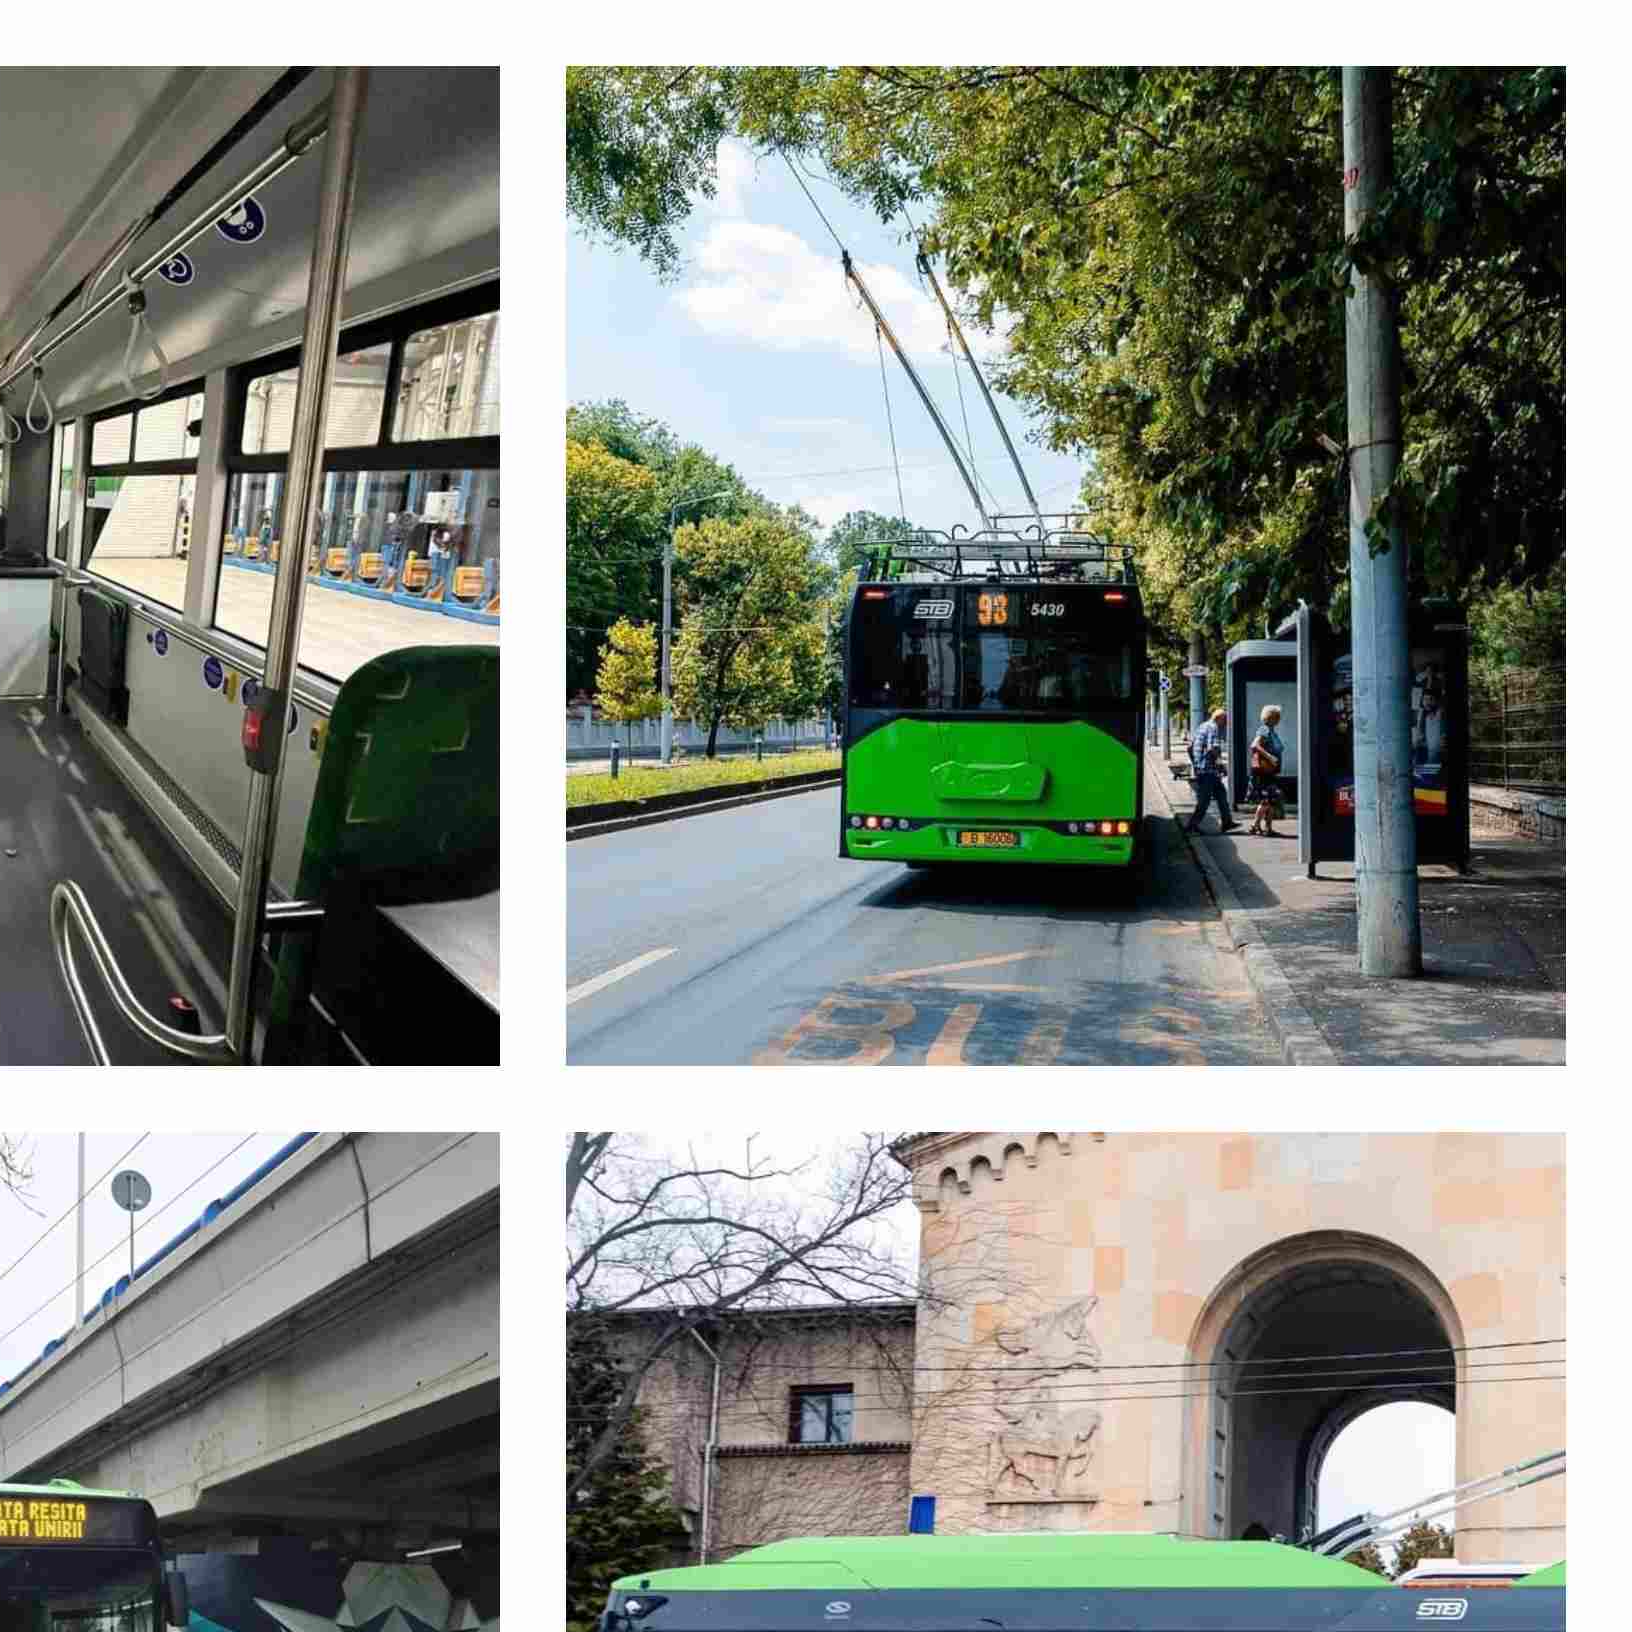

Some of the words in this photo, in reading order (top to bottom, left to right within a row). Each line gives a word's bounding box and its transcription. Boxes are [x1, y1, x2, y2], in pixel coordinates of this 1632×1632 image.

[914, 601, 951, 616] STB
[1031, 603, 1064, 616] 5430
[30, 1502, 86, 1521] RESITA
[34, 1521, 83, 1538] UNIRII
[1416, 1601, 1464, 1618] STB
